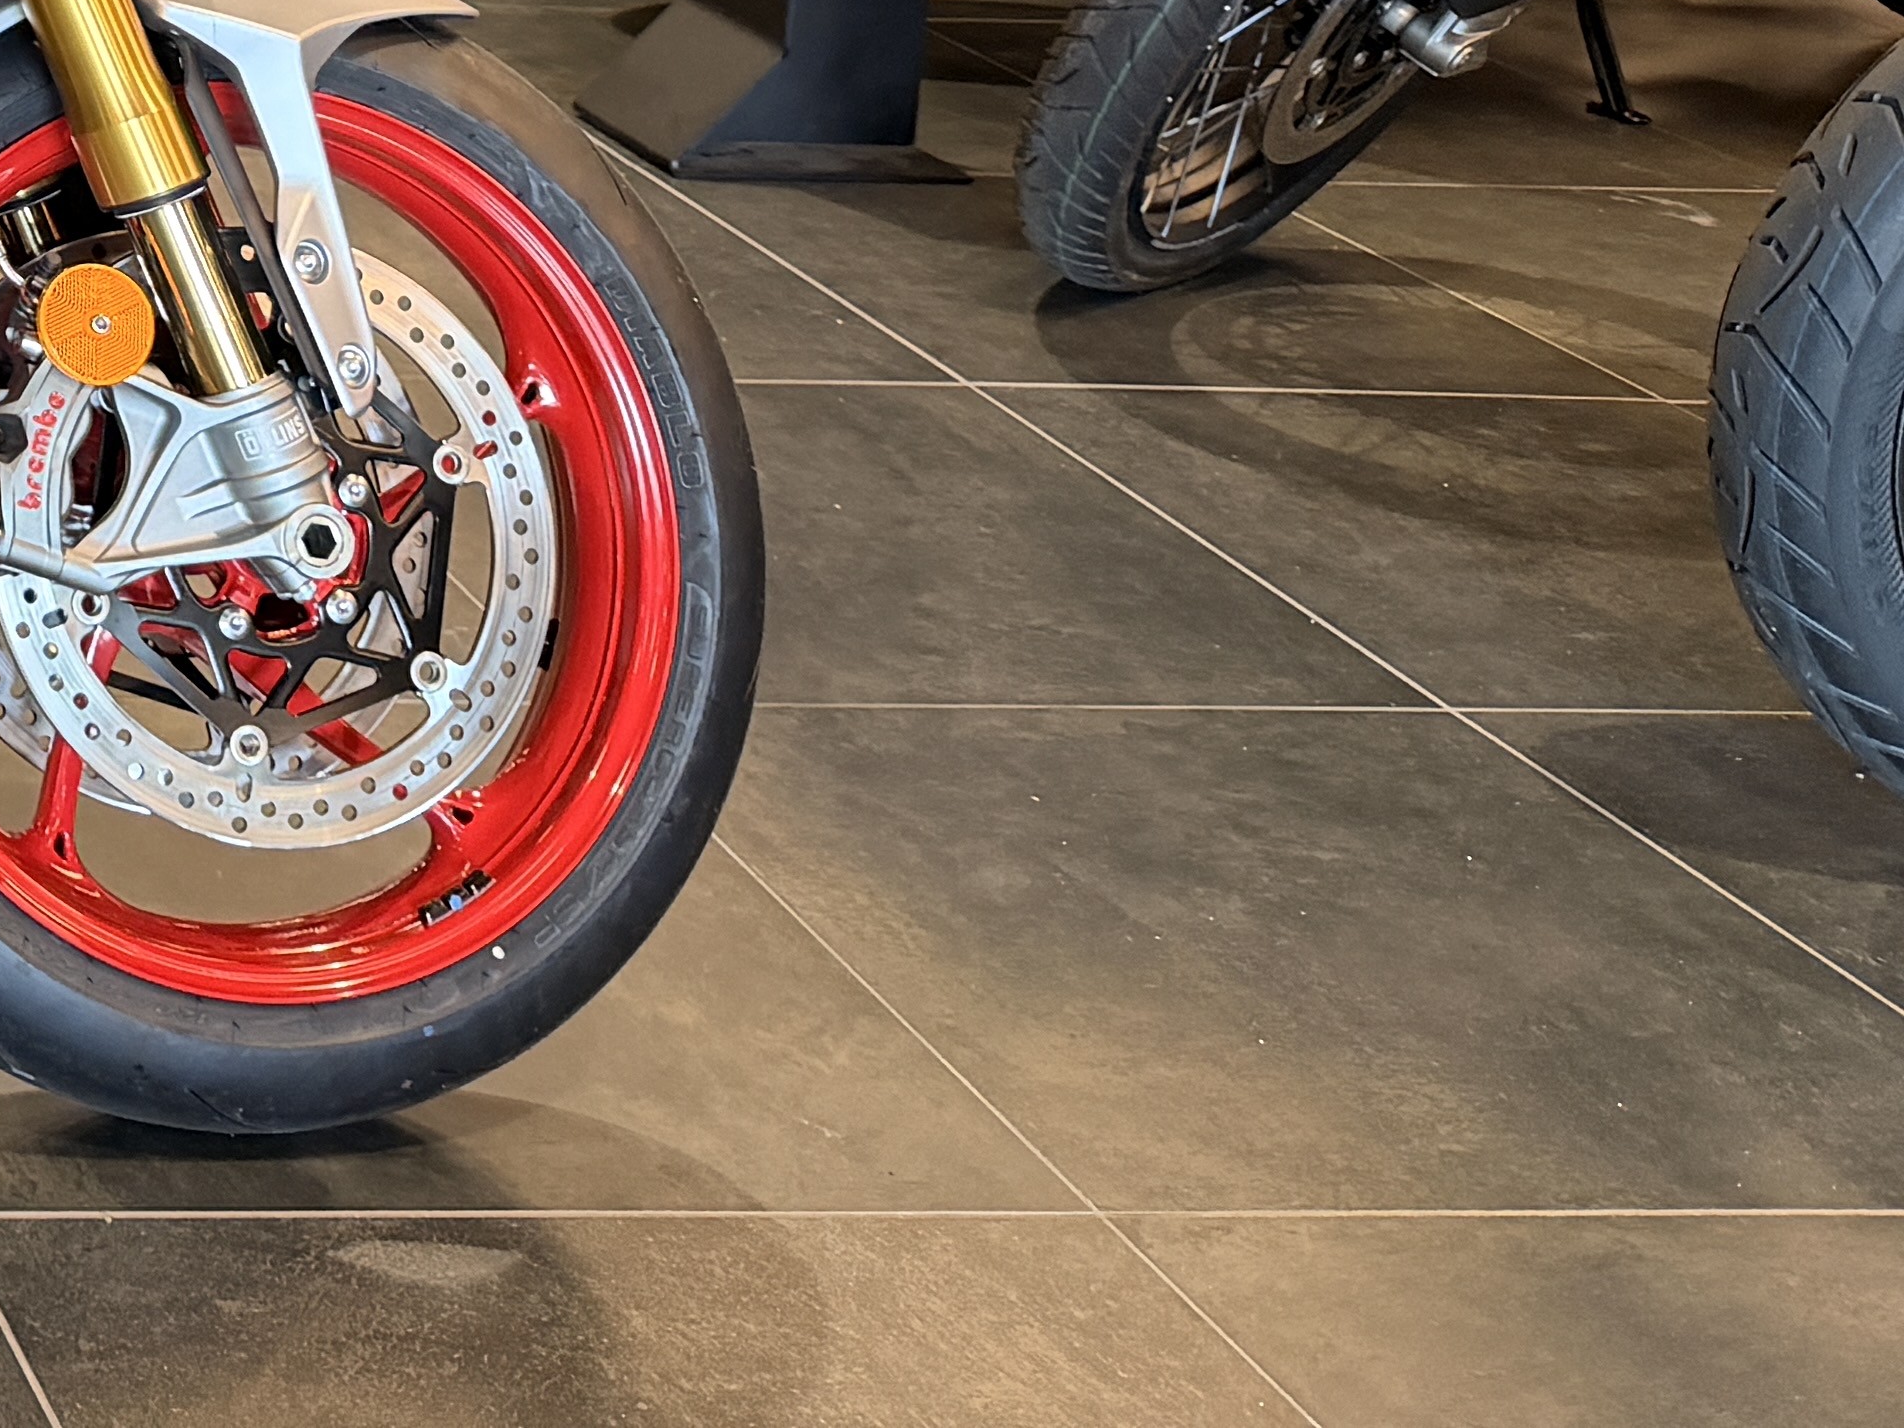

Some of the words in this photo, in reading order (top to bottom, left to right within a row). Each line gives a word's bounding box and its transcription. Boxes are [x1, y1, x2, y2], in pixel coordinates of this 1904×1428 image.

[243, 414, 306, 456] ÖLINS
[601, 273, 704, 490] DIABLO
[17, 390, 66, 511] brembo
